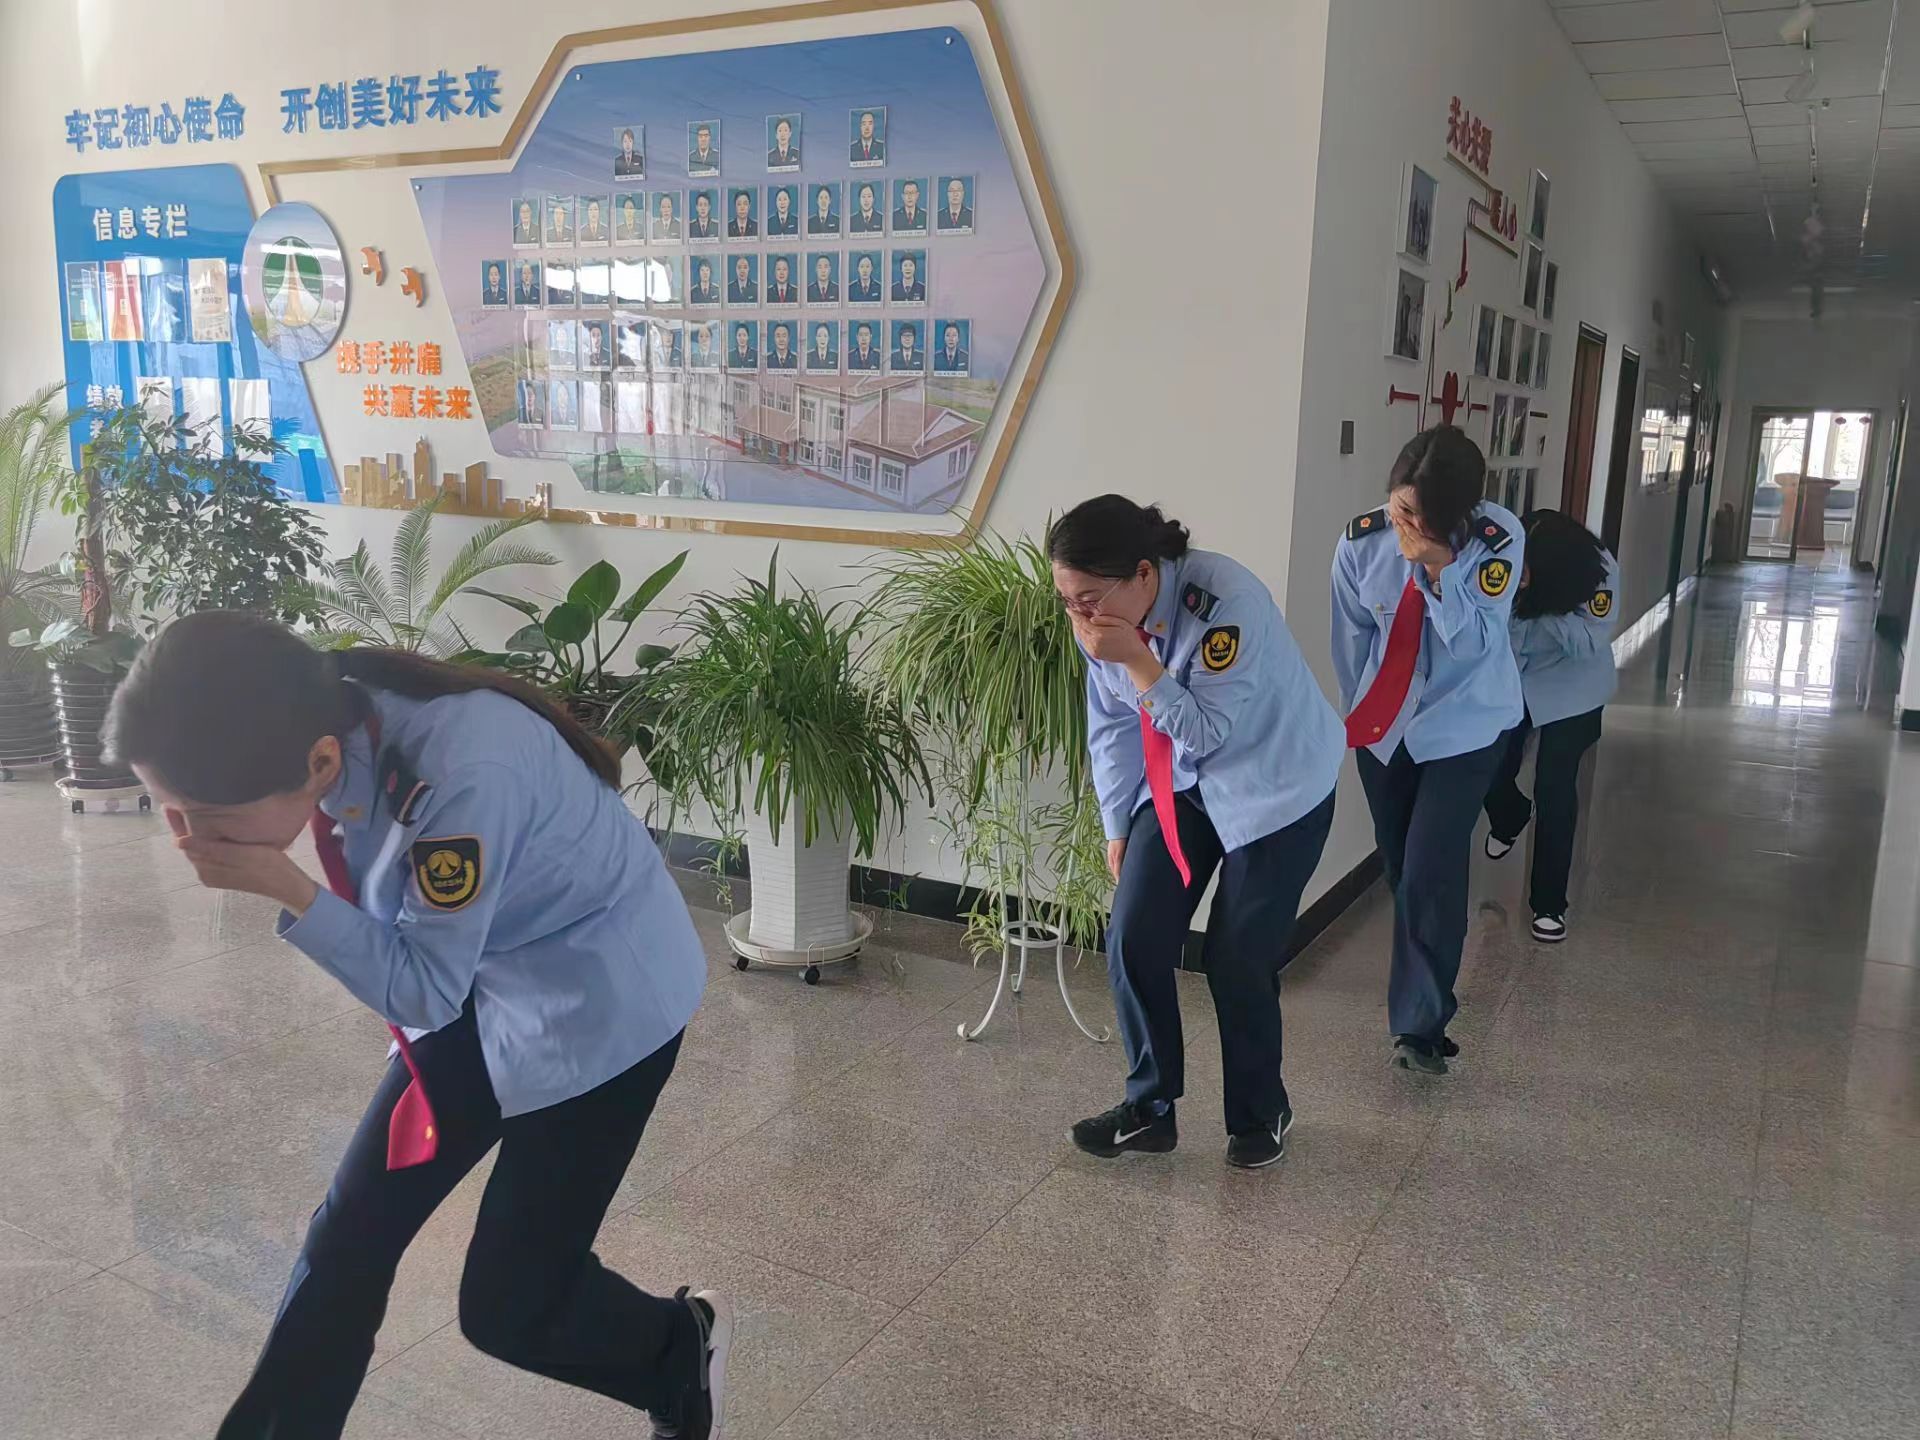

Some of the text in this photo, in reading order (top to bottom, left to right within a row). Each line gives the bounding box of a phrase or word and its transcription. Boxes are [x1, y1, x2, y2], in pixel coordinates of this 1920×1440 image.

[65, 64, 502, 152] 牢记初心使命 开创美好未来
[93, 204, 188, 241] 信息专栏
[336, 339, 442, 375] 携手并肩
[86, 383, 124, 412] 绩效
[363, 384, 472, 419] 共赢未来
